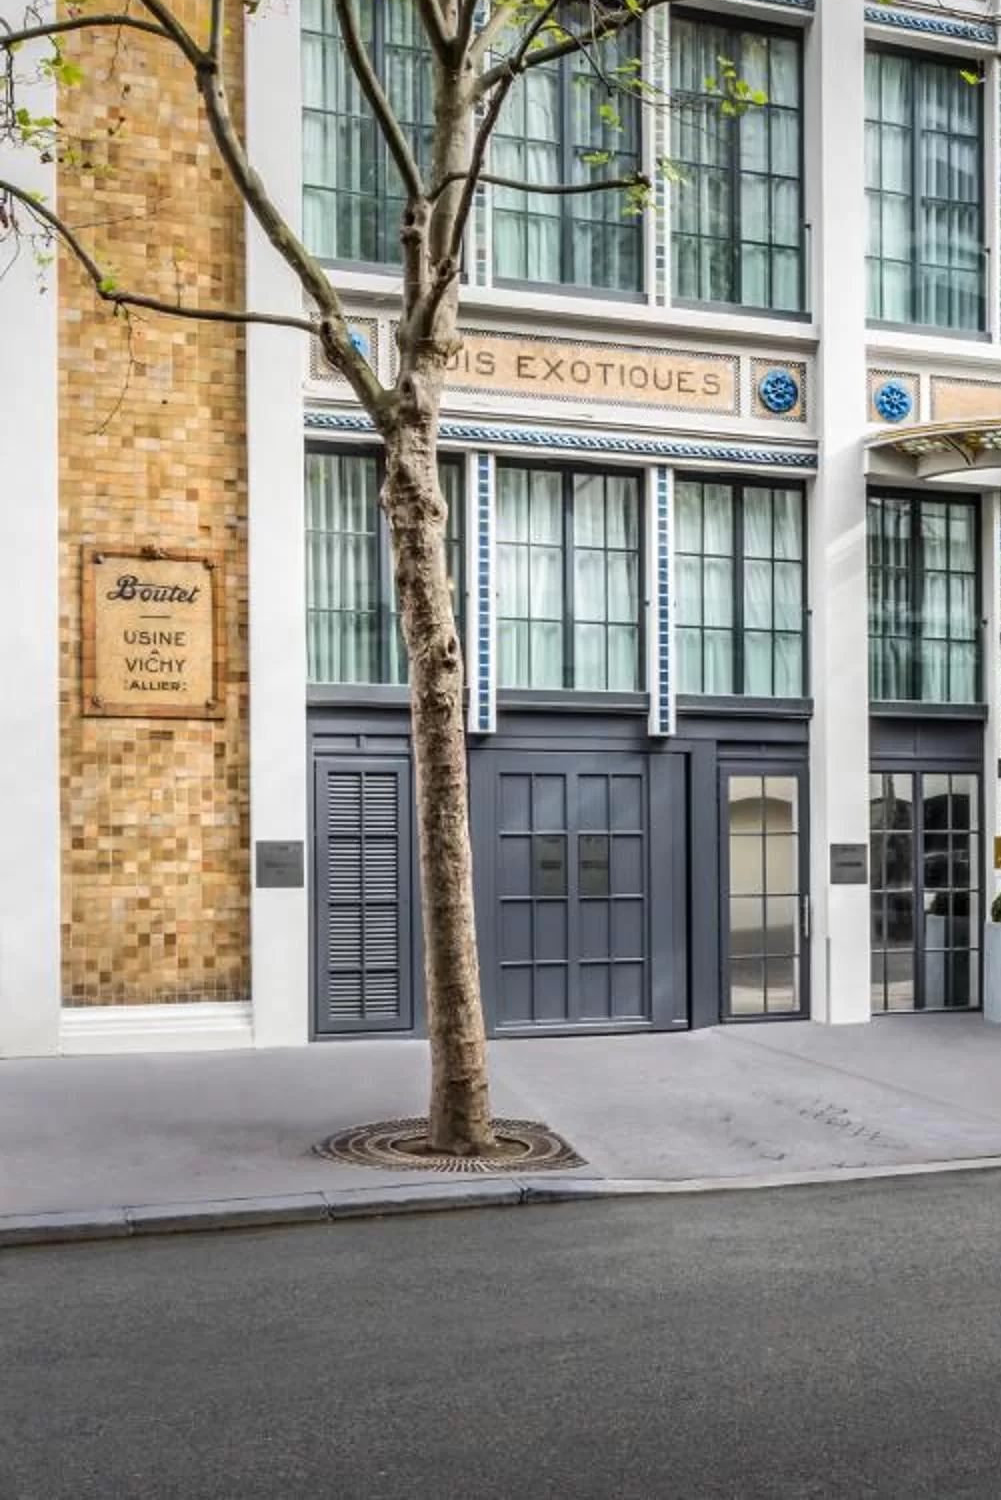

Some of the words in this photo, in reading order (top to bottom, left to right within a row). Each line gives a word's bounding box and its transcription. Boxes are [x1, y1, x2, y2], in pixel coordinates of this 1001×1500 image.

[516, 355, 721, 396] EXOTIQUES
[107, 574, 200, 604] Boutet
[124, 630, 186, 647] USINE
[125, 657, 186, 673] VICHY
